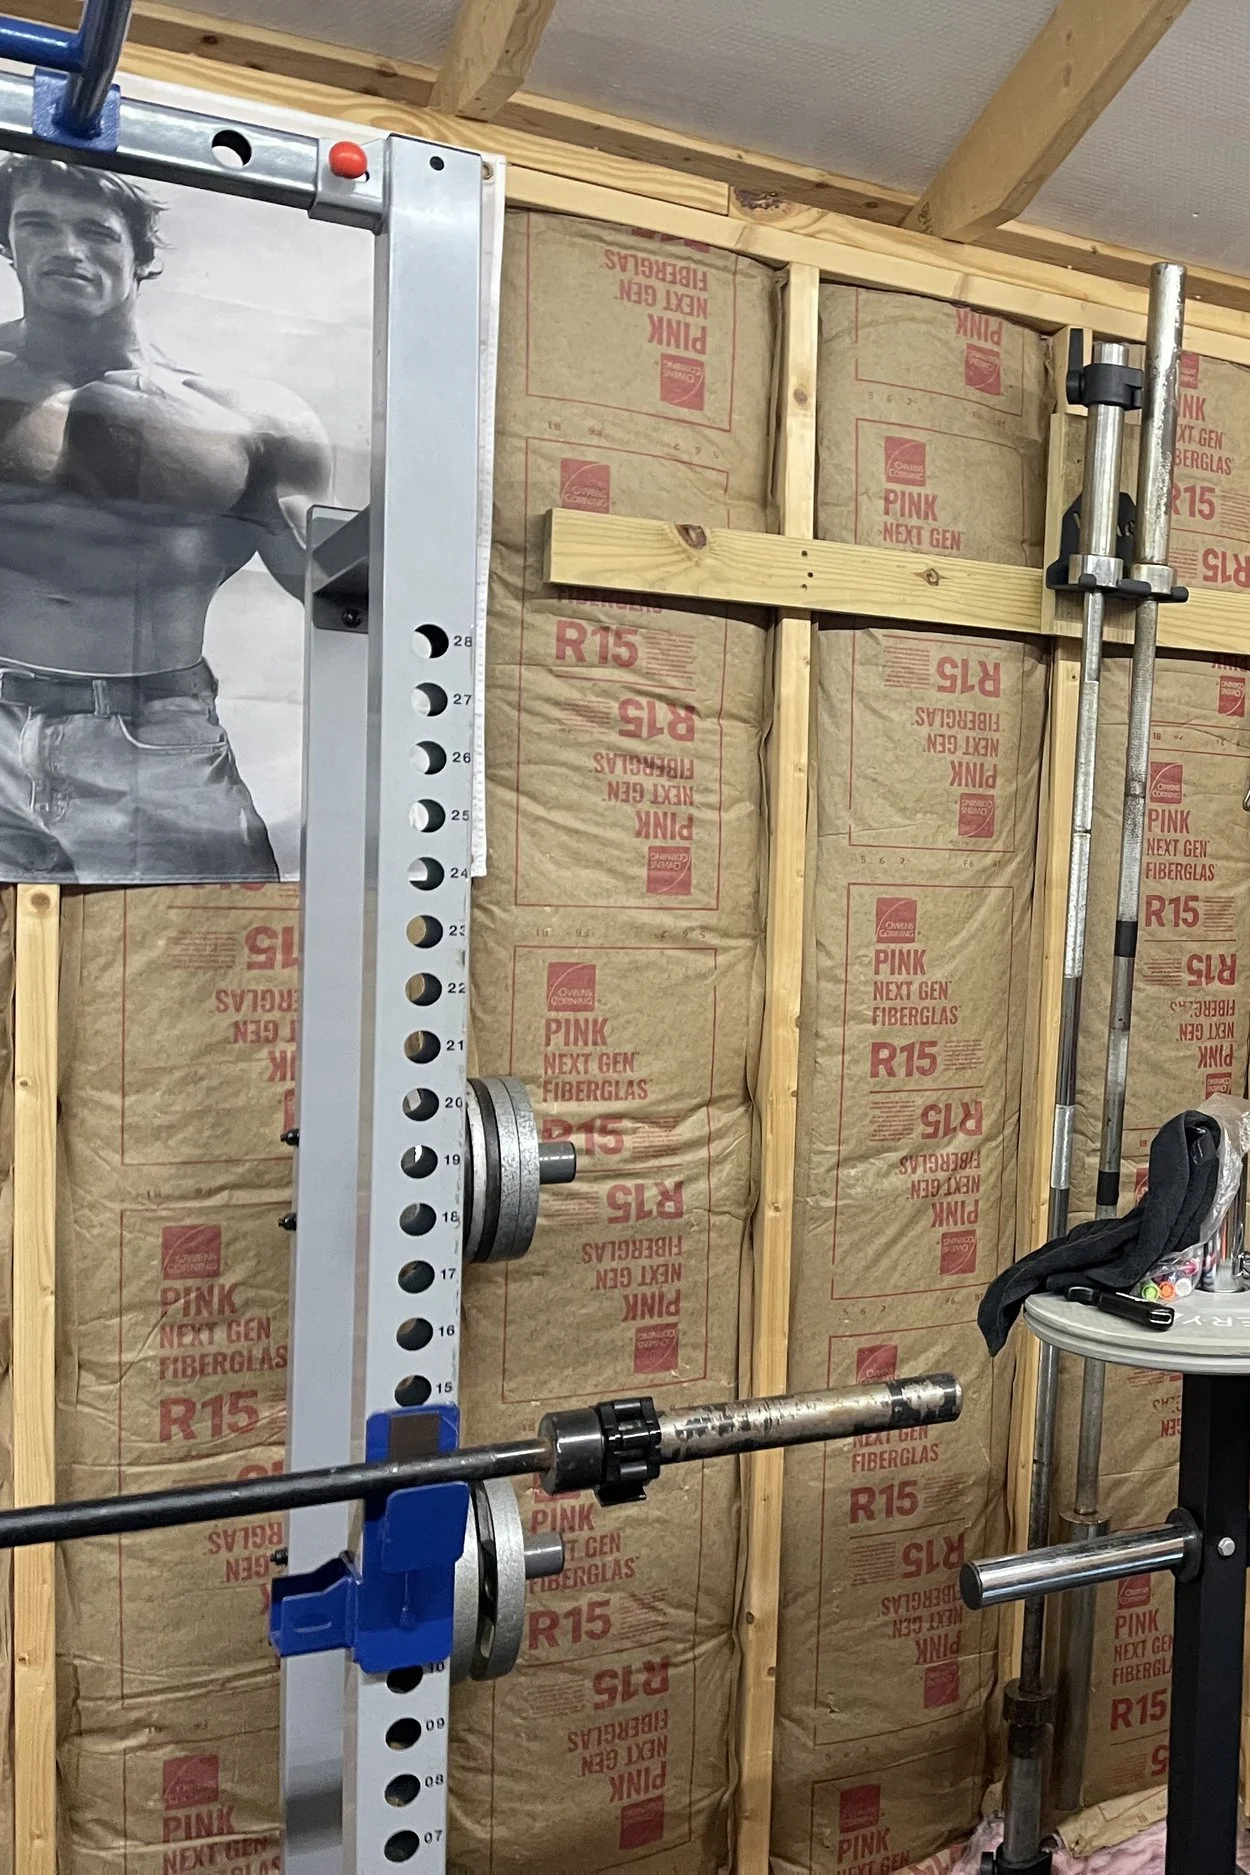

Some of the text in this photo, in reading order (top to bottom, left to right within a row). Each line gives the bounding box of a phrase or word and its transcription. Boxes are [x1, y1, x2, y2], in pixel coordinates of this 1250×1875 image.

[605, 249, 708, 291] FIBERGLAS
[619, 279, 708, 319] NEXT GEN
[648, 314, 707, 354] PINK
[956, 308, 1002, 346] PINK
[1179, 397, 1207, 422] INK
[1200, 429, 1223, 450] GEN
[1174, 451, 1232, 476] BERGLAS
[884, 488, 938, 522] PINK
[883, 521, 961, 552] NEXT GEN
[1202, 548, 1250, 588] R15
[453, 635, 472, 648] 28
[555, 620, 639, 667] R15
[936, 656, 1000, 698] R15
[453, 694, 471, 706] 27
[618, 698, 696, 742] R15
[915, 706, 1000, 732] FIBERGLAS
[452, 752, 471, 763] 26
[927, 733, 999, 758] NEXT GEN
[593, 752, 694, 779] FIBERGLAS
[950, 760, 997, 789] PINK
[607, 781, 694, 806] NEXT GEN
[451, 810, 469, 822] 25
[635, 810, 693, 841] PINK
[1148, 809, 1190, 834] PINK
[1146, 839, 1207, 857] NEXT GEN
[450, 868, 468, 879] 24
[1146, 861, 1215, 881] FIBERGLAS
[1144, 895, 1200, 928] R15
[874, 950, 926, 975] PINK
[1187, 954, 1236, 987] R15
[447, 983, 466, 994] 22
[873, 981, 948, 1001] NEXT GEN
[872, 1006, 958, 1026] FIBERGLAS
[233, 1020, 278, 1044] GEN
[446, 1039, 464, 1051] 21
[544, 1018, 608, 1046] PINK
[1180, 1022, 1234, 1041] NEXT GEN
[544, 1052, 636, 1075] NEXT GEN
[870, 1040, 939, 1078] R15
[1198, 1044, 1233, 1069] PINK
[444, 1096, 462, 1108] 20
[543, 1079, 648, 1102] FIBERGLAS
[921, 1101, 982, 1140] R15
[443, 1154, 460, 1166] 19
[899, 1152, 981, 1176] FIBERGLAS
[911, 1174, 980, 1199] NEXT GEN
[441, 1211, 458, 1223] 18
[607, 1181, 684, 1225] R15
[931, 1199, 979, 1228] PINK
[582, 1235, 682, 1264] FIBERGLAS
[440, 1268, 456, 1280] 17
[595, 1262, 681, 1290] NEXT GEN
[160, 1283, 238, 1319] PINK
[622, 1293, 680, 1322] PINK
[159, 1317, 271, 1349] NEXT GEN
[437, 1326, 455, 1338] 16
[159, 1345, 287, 1381] FIBERGLAS
[435, 1382, 452, 1394] 15
[159, 1390, 260, 1443] R15
[898, 1425, 928, 1441] GEN
[852, 1443, 939, 1473] FIBERGLAS
[850, 1480, 918, 1524] R15
[530, 1504, 594, 1535] PINK
[584, 1532, 621, 1557] GEN
[903, 1532, 964, 1579] R15
[225, 1558, 270, 1583] GEN
[528, 1557, 635, 1595] FIBERGLAS
[528, 1598, 611, 1650] R15
[892, 1606, 963, 1639] NEXT GEN
[1115, 1609, 1159, 1639] PINK
[916, 1630, 962, 1665] PINK
[1113, 1639, 1147, 1662] NEXT
[429, 1661, 445, 1673] 10
[592, 1654, 670, 1711] R15
[1110, 1688, 1167, 1731] R15
[425, 1717, 445, 1731] 09
[568, 1709, 668, 1752] FIBERGLAS
[582, 1736, 667, 1776] NEXT GEN
[425, 1774, 444, 1787] 08
[609, 1761, 666, 1802] PINK
[163, 1804, 235, 1843] PINK
[424, 1830, 442, 1843] 07
[837, 1827, 890, 1864] PINK
